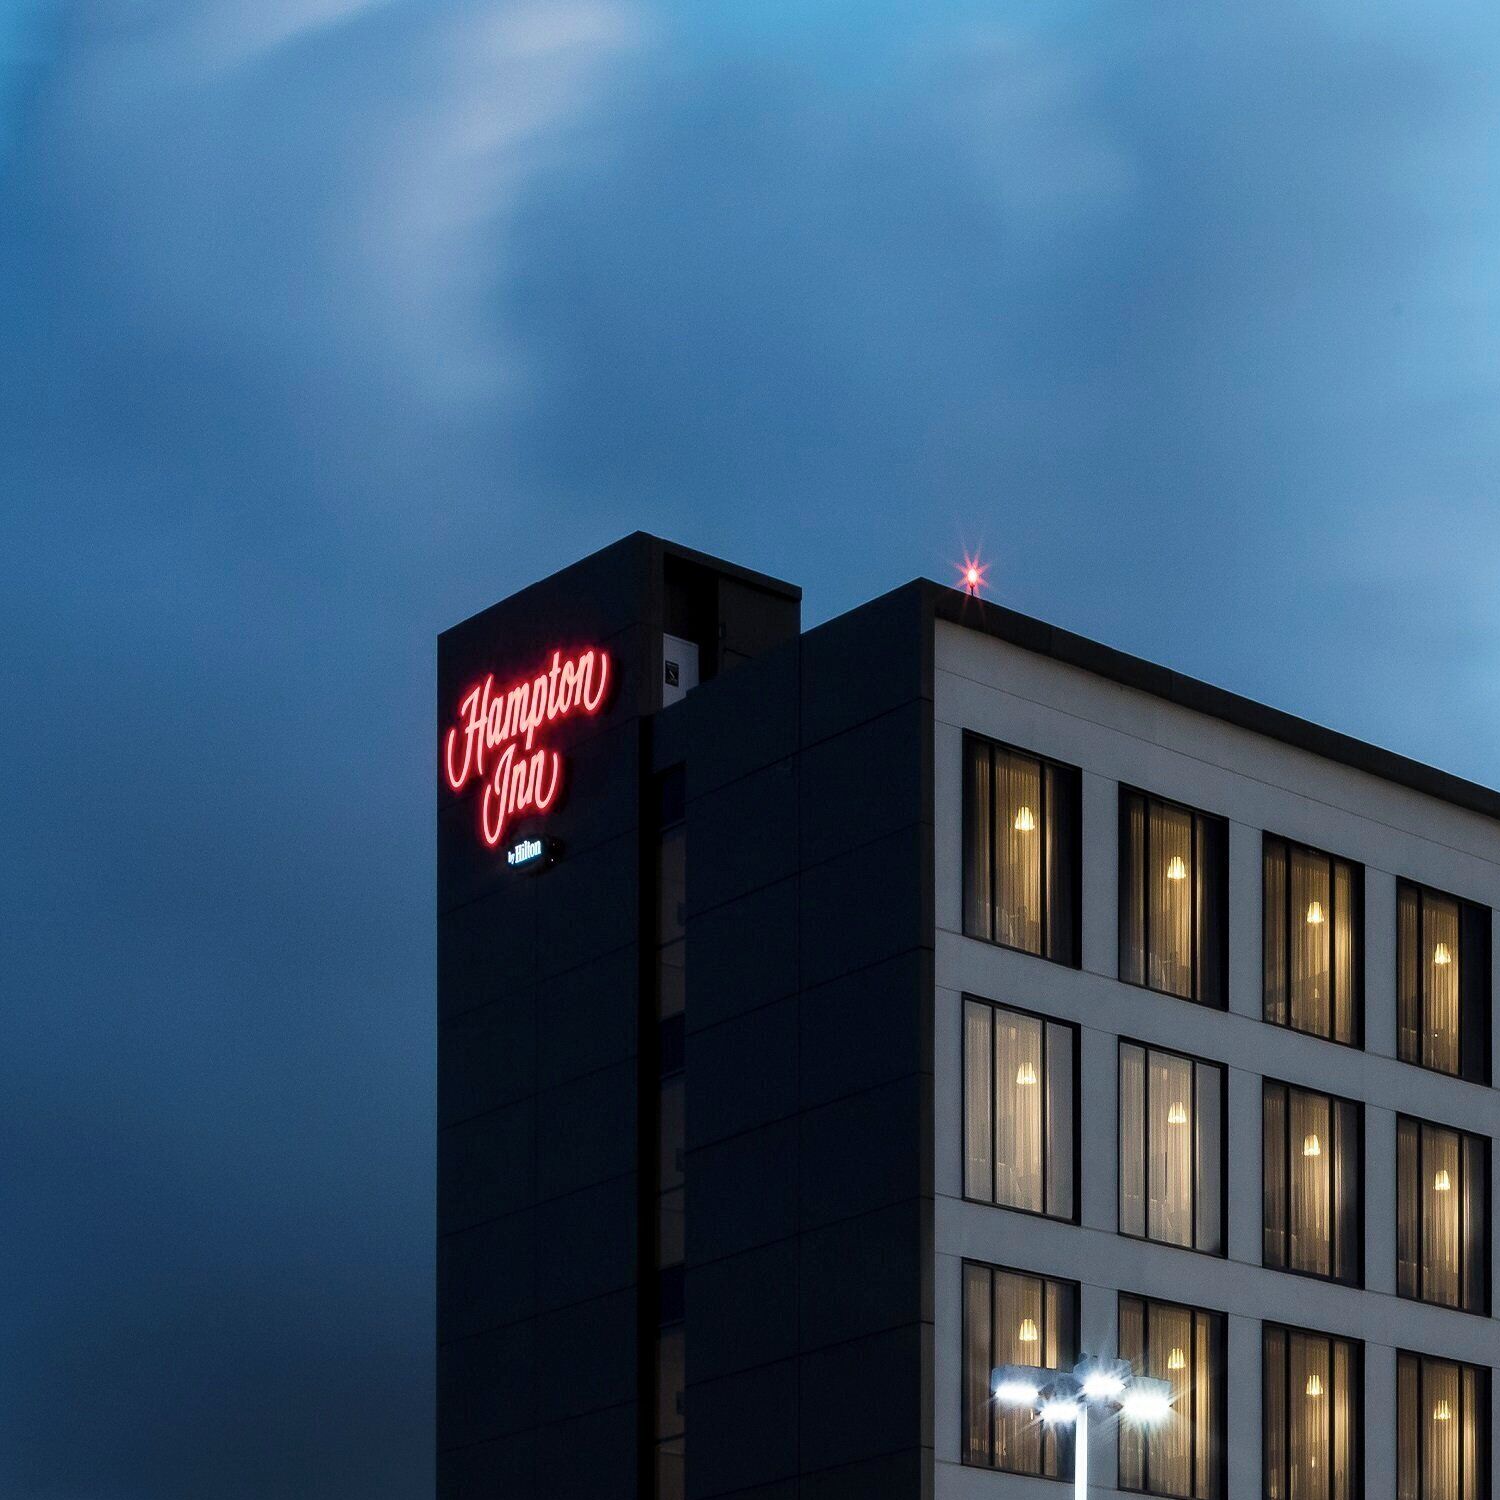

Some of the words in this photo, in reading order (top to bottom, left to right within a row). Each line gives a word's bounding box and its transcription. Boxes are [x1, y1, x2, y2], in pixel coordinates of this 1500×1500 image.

[447, 650, 608, 788] Hampton
[482, 743, 560, 845] Inn
[507, 850, 516, 865] by
[514, 840, 542, 864] Hilton
